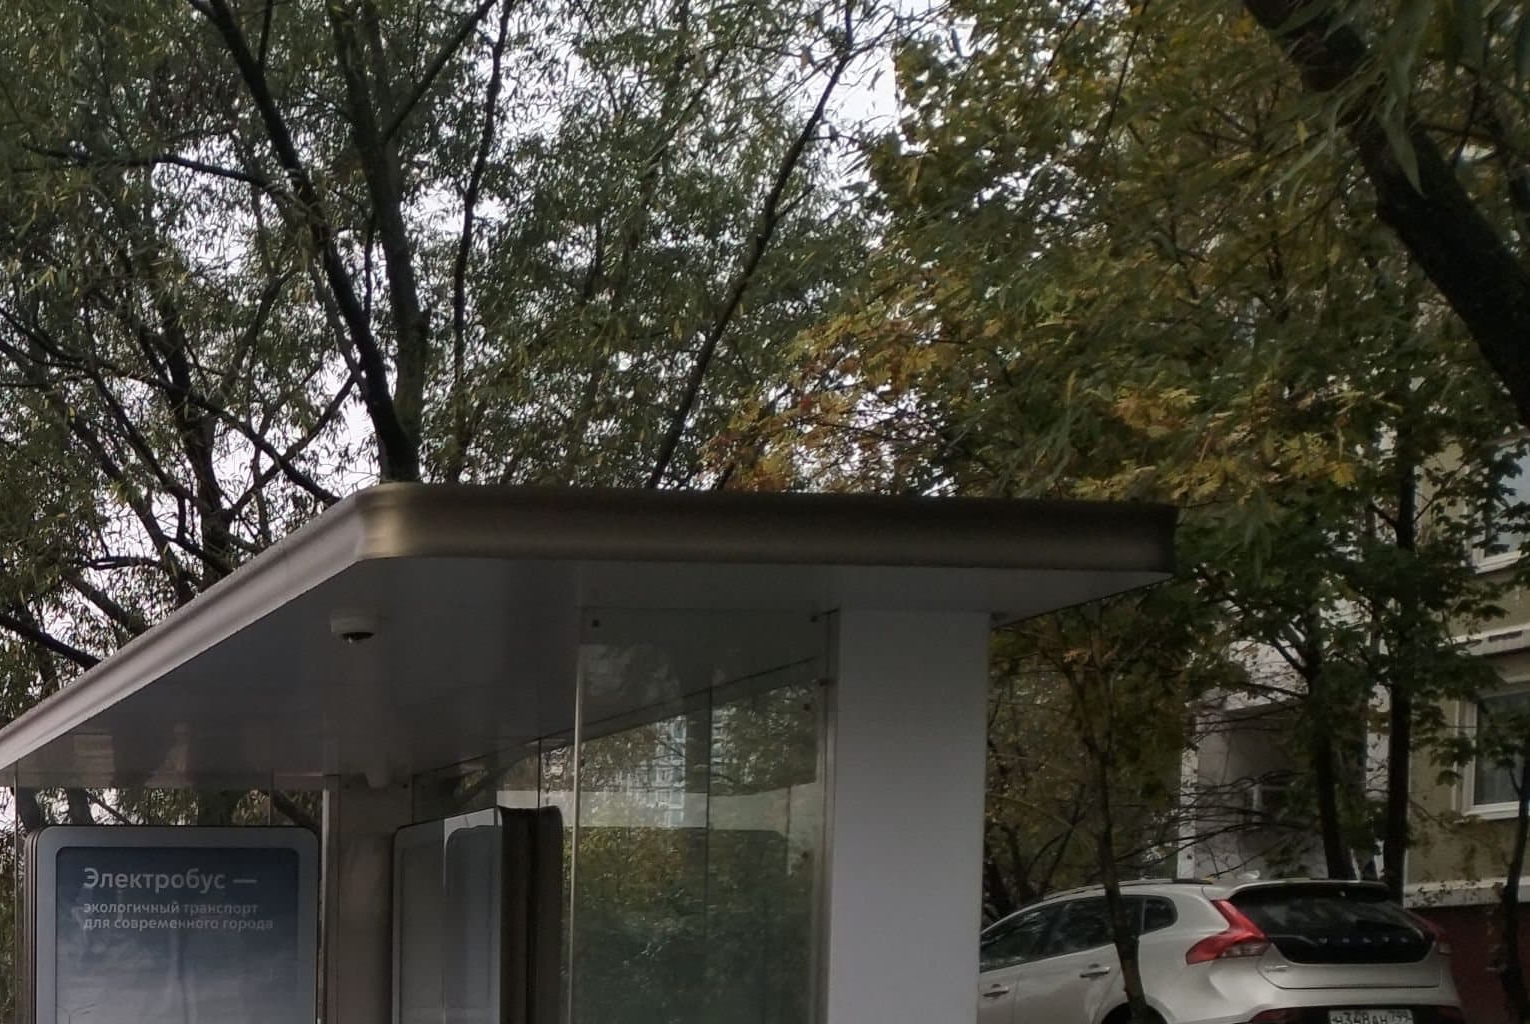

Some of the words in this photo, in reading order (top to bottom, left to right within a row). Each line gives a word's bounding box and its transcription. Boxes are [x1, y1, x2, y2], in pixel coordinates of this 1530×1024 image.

[83, 867, 226, 894] Электробус
[83, 901, 179, 913] экологичный
[183, 904, 258, 916] транспорт
[83, 918, 110, 930] для
[114, 919, 219, 931] современного
[223, 919, 273, 932] города
